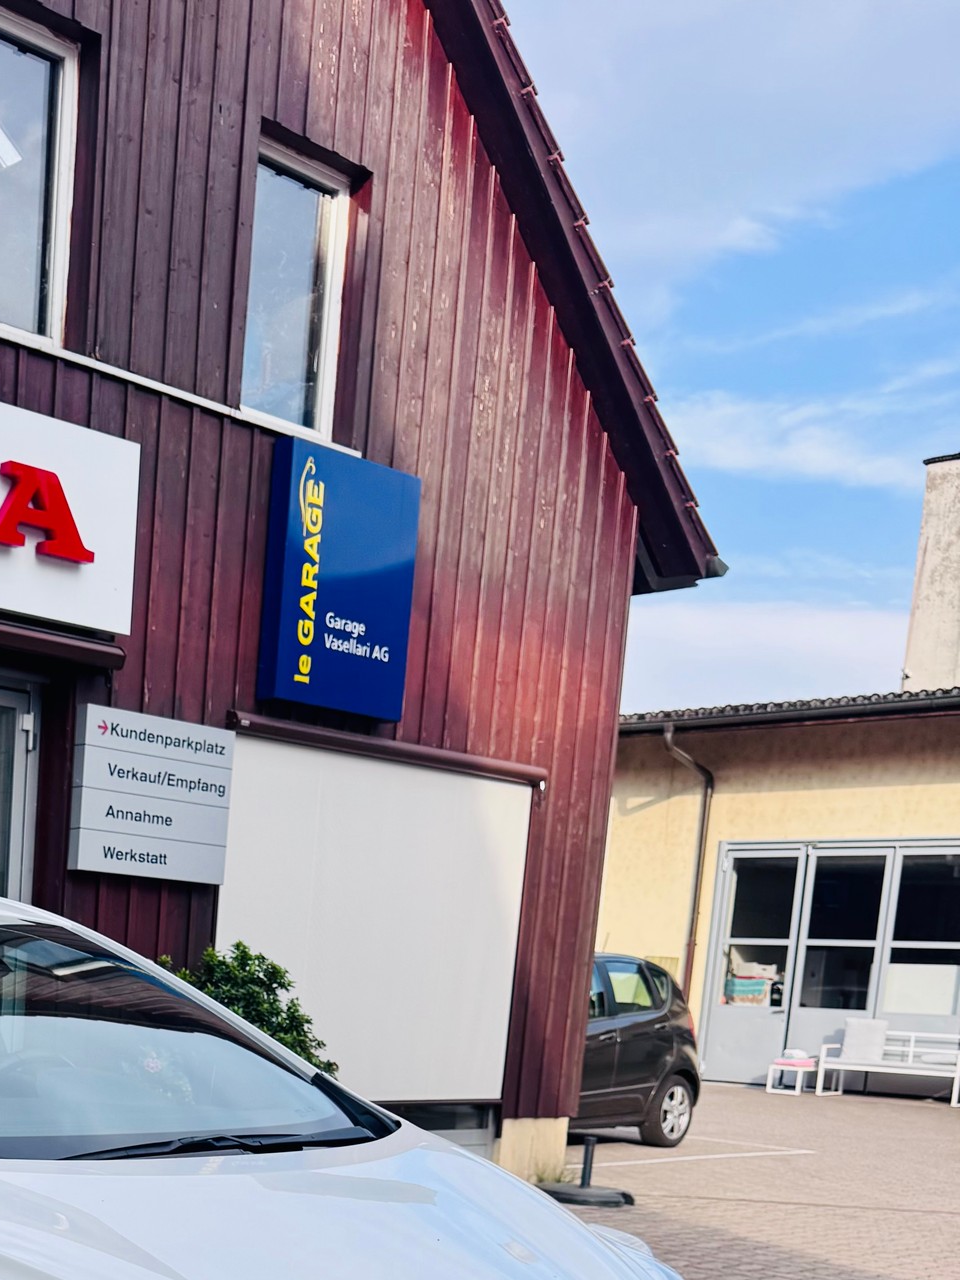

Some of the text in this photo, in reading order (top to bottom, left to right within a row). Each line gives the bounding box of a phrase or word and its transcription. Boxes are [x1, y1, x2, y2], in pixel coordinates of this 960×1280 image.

[293, 479, 325, 684] le GARAGE
[325, 612, 366, 638] Garage
[324, 633, 390, 663] Vasellari AG
[110, 722, 226, 756] Kundenparkplatz
[108, 763, 226, 797] Verkauf/Empfang
[105, 805, 173, 827] Annahme
[103, 846, 168, 866] Werkstatt
